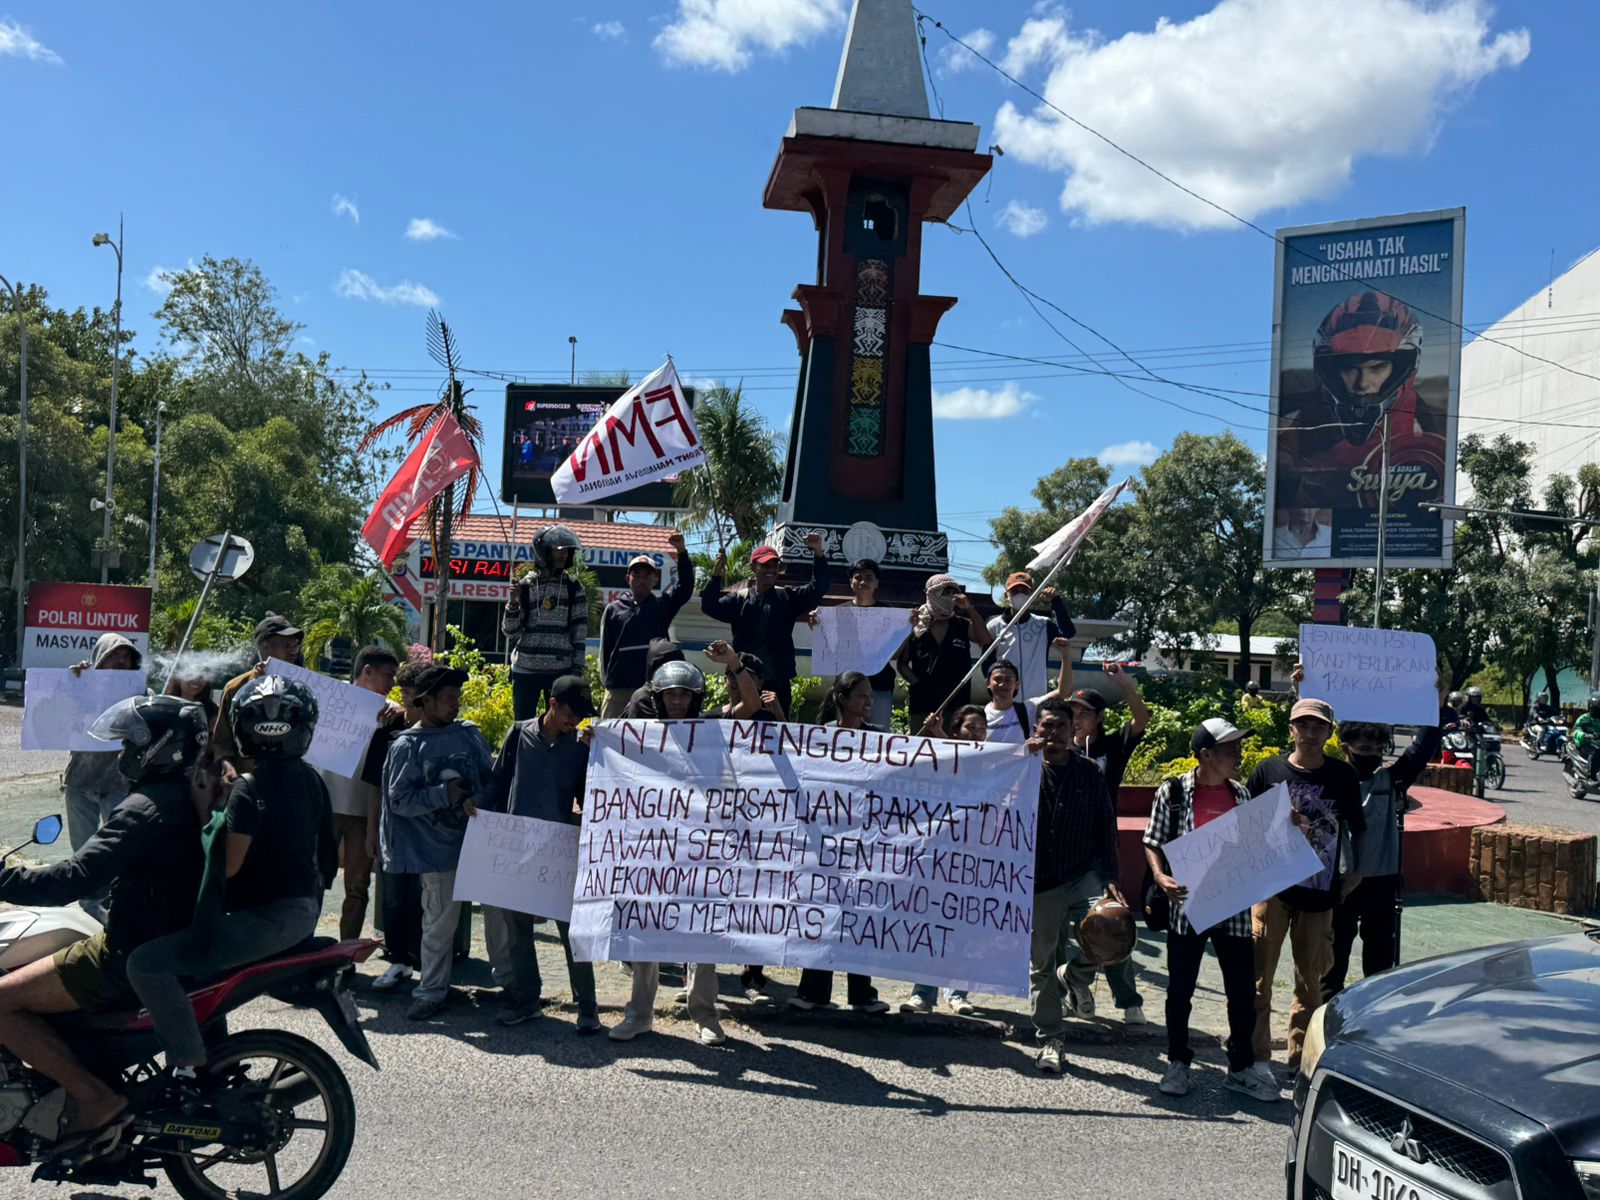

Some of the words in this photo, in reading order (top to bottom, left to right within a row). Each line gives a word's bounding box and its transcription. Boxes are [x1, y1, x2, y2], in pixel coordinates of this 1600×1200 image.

[1319, 239, 1374, 262] “USAHA
[1377, 236, 1405, 256] TAK
[1291, 257, 1395, 285] MENGKHIANATI
[1399, 252, 1449, 275] HASIL”
[420, 541, 460, 556] PS
[38, 609, 82, 625] POLRI
[86, 611, 139, 628] UNTUK
[1305, 646, 1344, 669] YANG
[1347, 652, 1430, 673] MERUGIKAN
[1322, 670, 1398, 692] RAKYAT
[704, 787, 853, 827] PERSATUAN
[588, 828, 679, 864] LAWAN
[687, 829, 808, 865] SEGALAH
[819, 835, 927, 879] BENTUK
[932, 848, 1034, 895] KEBIJAK-
[582, 868, 607, 897] AN
[610, 866, 699, 897] EKONOMI
[704, 867, 803, 901] POLITIK
[809, 873, 1031, 935] PRABOWO-GIBRAN
[613, 900, 681, 932] YANG
[689, 903, 825, 940] MENINDAS
[839, 910, 955, 958] RAKYAT
[166, 1124, 218, 1137] DAYTONA
